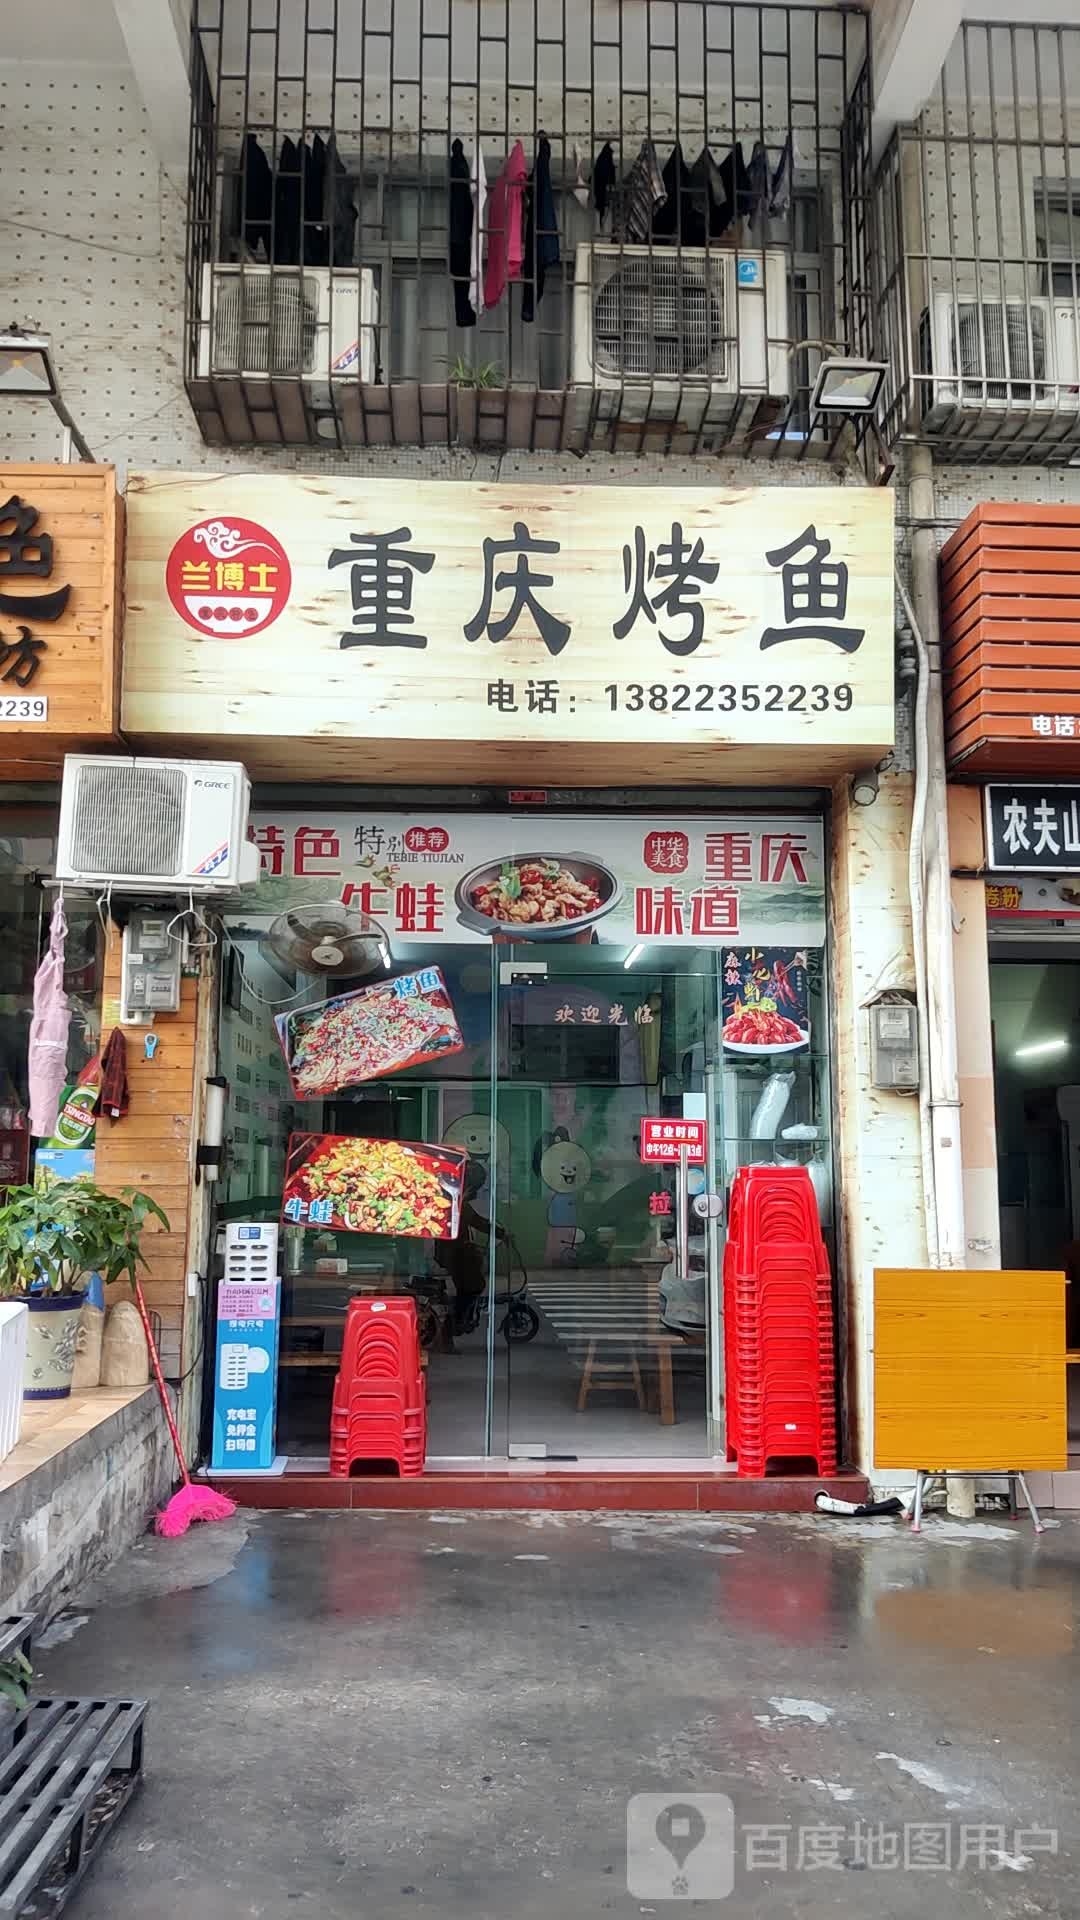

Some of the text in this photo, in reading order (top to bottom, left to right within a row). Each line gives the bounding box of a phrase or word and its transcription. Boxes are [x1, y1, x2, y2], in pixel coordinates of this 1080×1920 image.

[181, 560, 279, 593] 兰博士
[329, 521, 866, 657] 重庆烤鱼
[1002, 797, 1080, 857] 农夫山
[248, 825, 342, 876] 特色
[354, 825, 406, 856] 特别
[408, 831, 445, 849] 推荐
[386, 853, 419, 864] TEBIE
[651, 836, 685, 853] 中华
[704, 832, 809, 883] 重庆
[650, 852, 685, 869] 美食
[340, 882, 445, 933] 牛蛙
[635, 886, 741, 937] 味道
[393, 968, 442, 1000] 烤鱼
[553, 1003, 655, 1026] 欢迎光临
[650, 1125, 699, 1139] 营业时间
[646, 1143, 703, 1157] 中午12点~3点
[284, 1197, 334, 1224] 牛蛙
[649, 1191, 672, 1216] 拉
